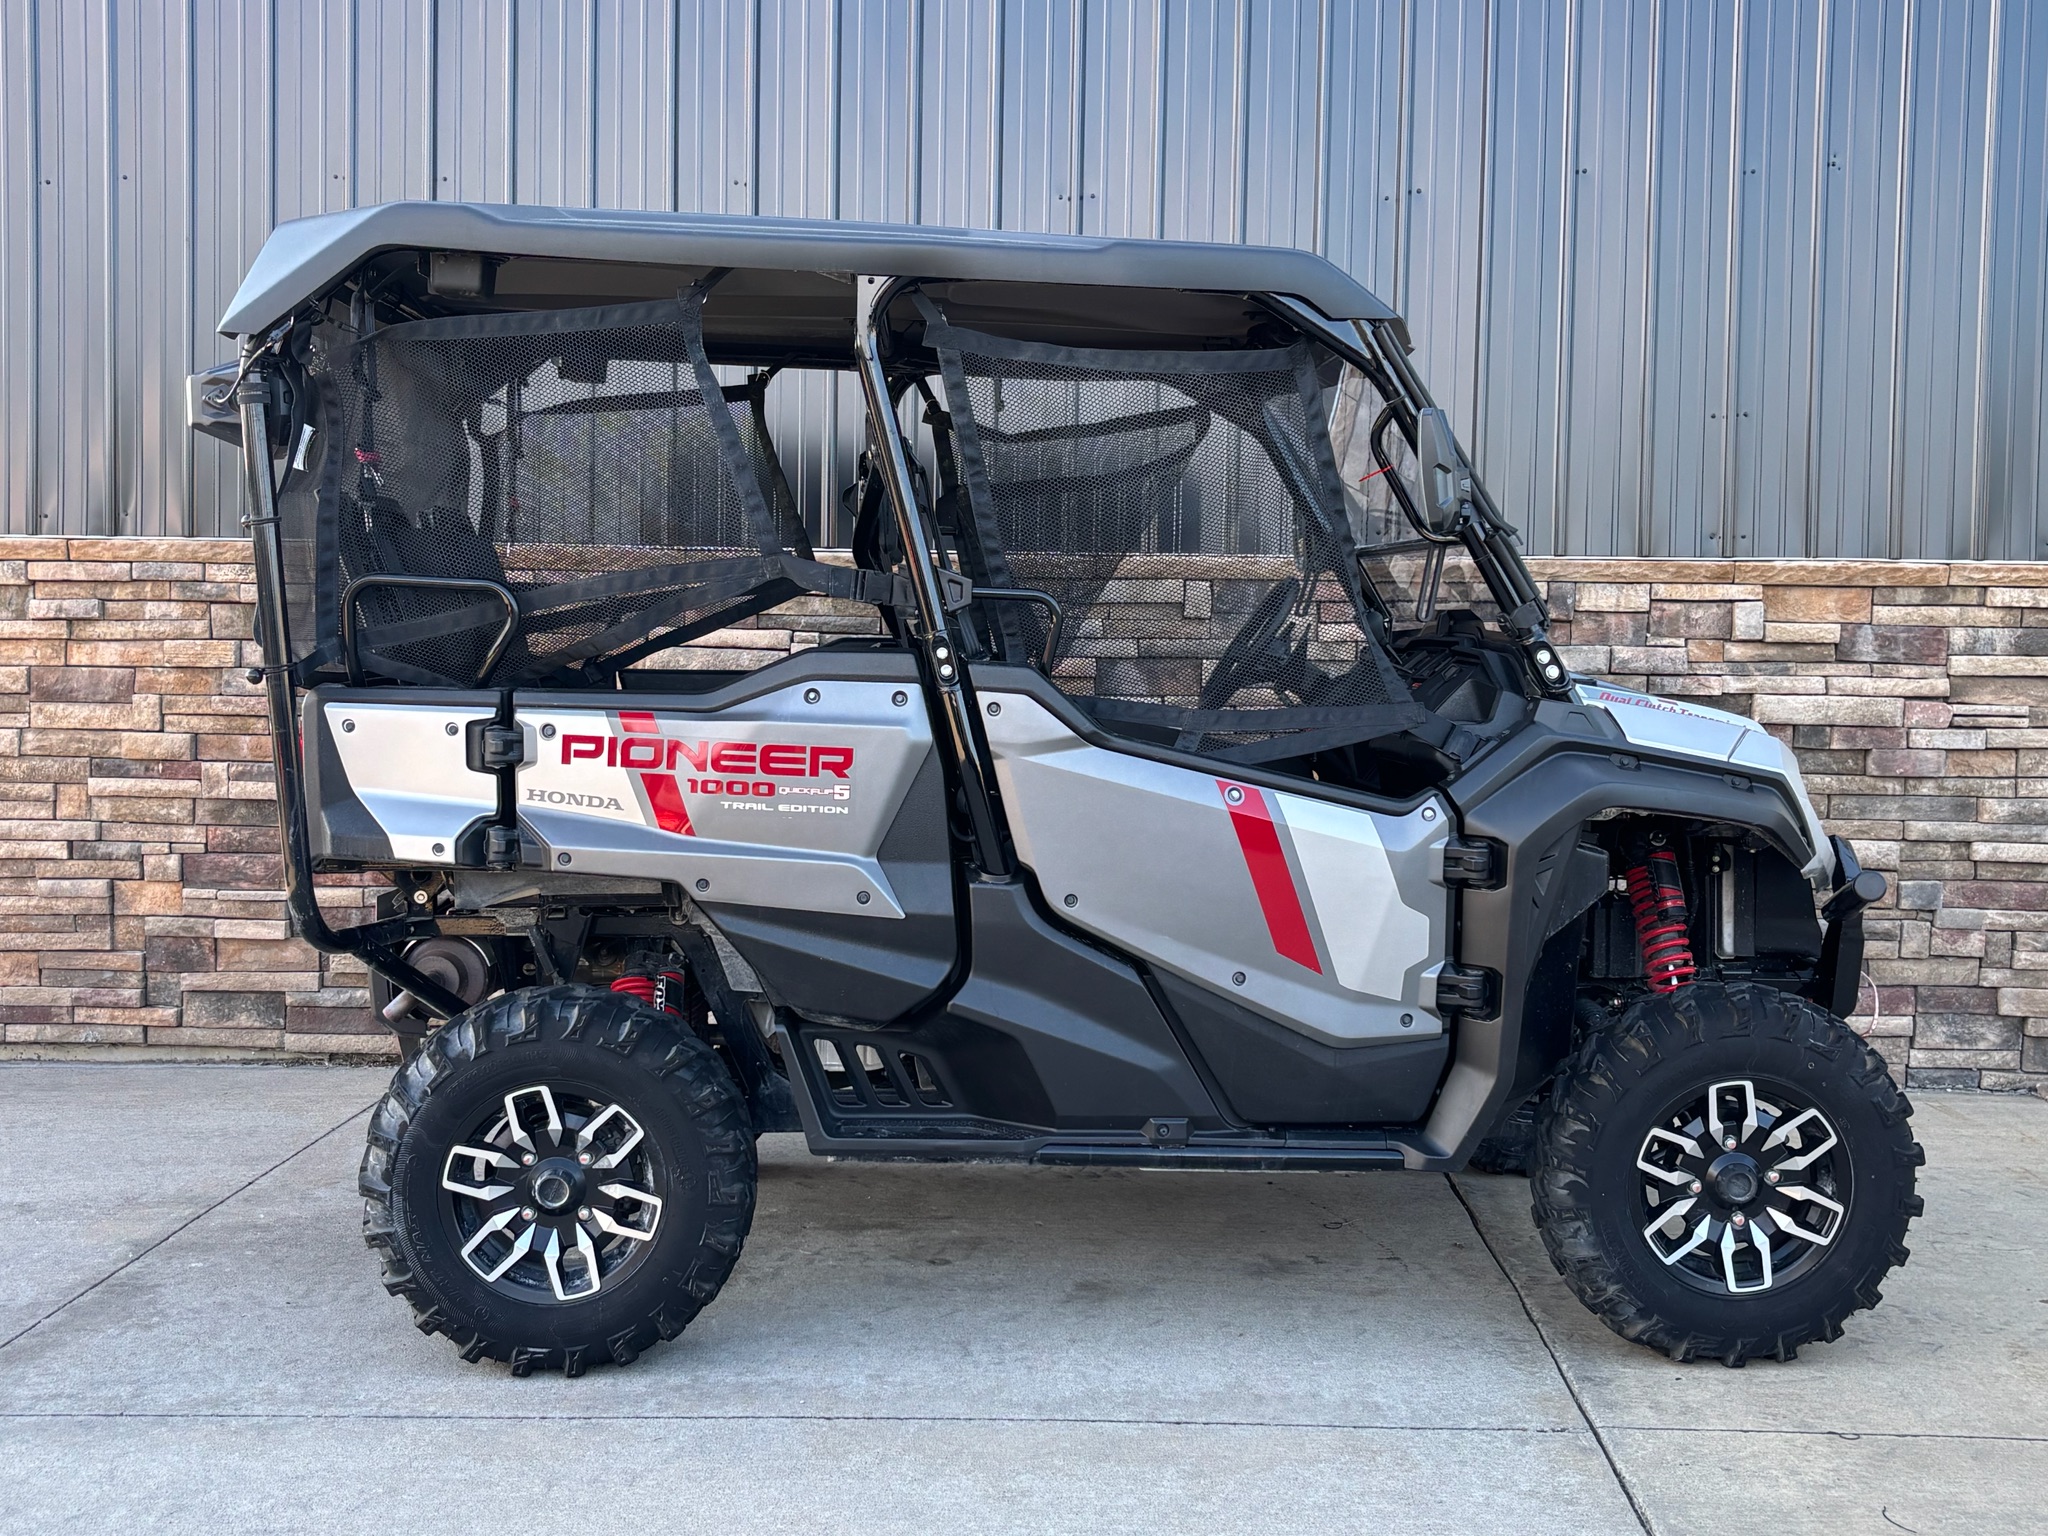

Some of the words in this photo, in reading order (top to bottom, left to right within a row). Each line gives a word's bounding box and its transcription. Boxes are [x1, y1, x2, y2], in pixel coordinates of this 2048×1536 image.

[1599, 691, 1632, 705] Dual
[561, 734, 854, 779] PIONEER
[687, 777, 776, 798] 1000
[526, 788, 625, 811] HONDA
[720, 801, 774, 811] TRAIL
[778, 804, 849, 814] EDITION
